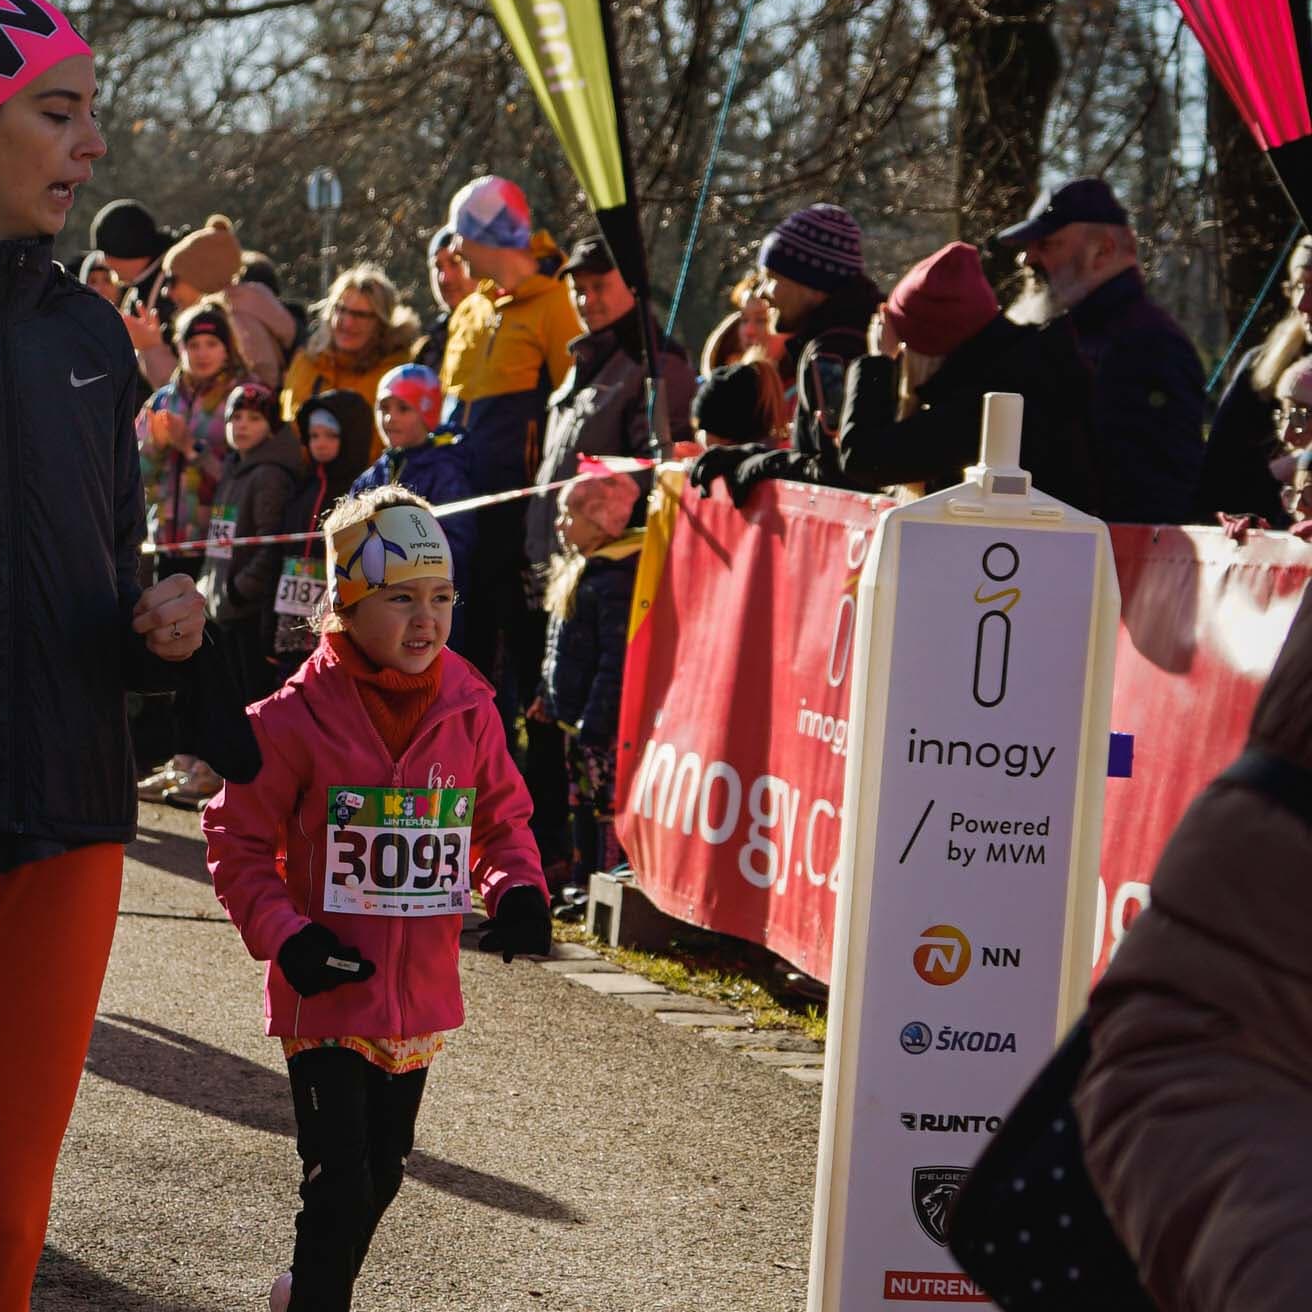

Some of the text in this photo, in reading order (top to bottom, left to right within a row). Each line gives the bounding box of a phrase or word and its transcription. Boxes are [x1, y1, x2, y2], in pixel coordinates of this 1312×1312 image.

[798, 699, 848, 756] innog
[908, 728, 1055, 778] innogy
[949, 812, 1050, 837] Powered
[331, 830, 460, 889] 3093
[946, 840, 1046, 867] by MVM
[982, 947, 1021, 967] NN
[936, 1026, 1016, 1053] ŠKODA
[919, 1172, 968, 1181] PEUGEO
